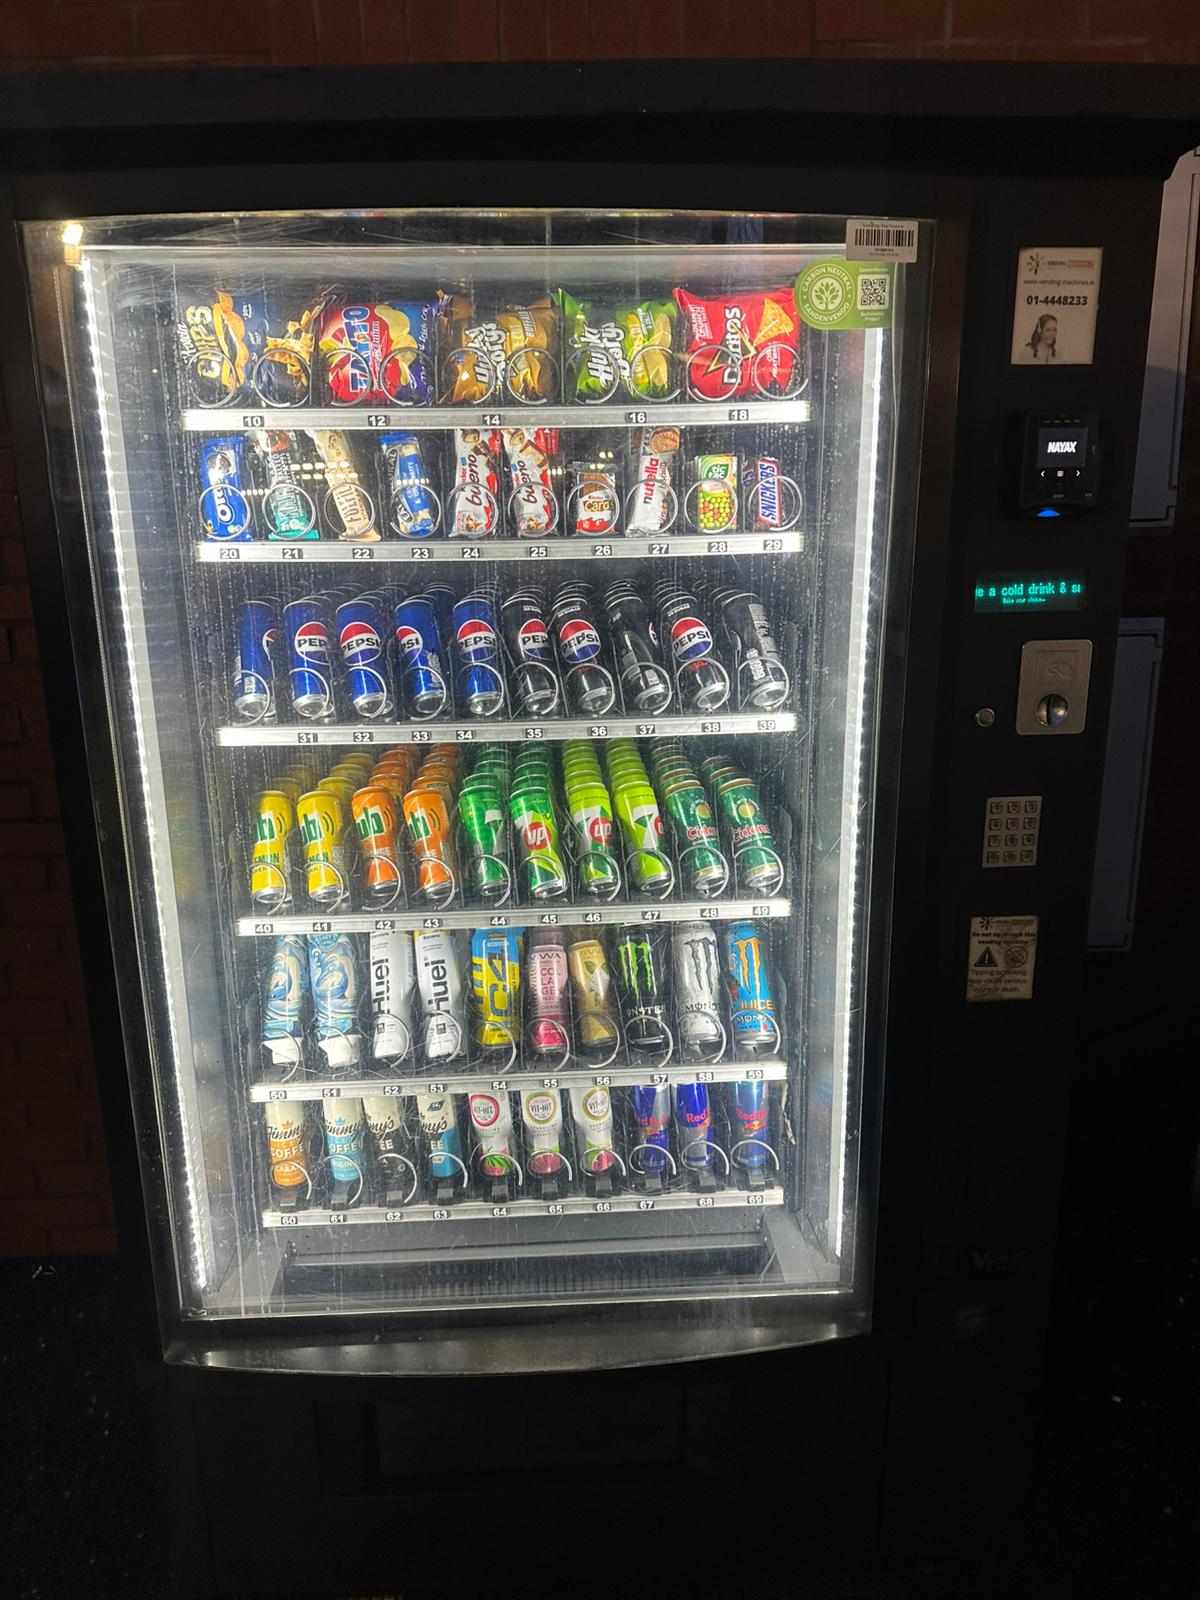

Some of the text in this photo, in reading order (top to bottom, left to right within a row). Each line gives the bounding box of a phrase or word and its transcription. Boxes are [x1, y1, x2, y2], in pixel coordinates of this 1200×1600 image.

[802, 266, 852, 292] CARBON NEUTRAL
[1026, 295, 1088, 306] 01-4448233
[804, 302, 850, 322] SANDENVENDO
[630, 413, 646, 423] 16
[731, 410, 748, 420] 18
[245, 417, 261, 427] 10
[369, 415, 386, 426] 12
[484, 415, 500, 425] 14
[1047, 441, 1077, 453] NAYAX
[711, 464, 726, 473] tic
[708, 471, 725, 479] tac
[465, 454, 483, 507] bueno
[517, 460, 538, 504] bueno
[643, 457, 660, 505] nutella
[759, 463, 777, 521] SNICKERS
[584, 499, 615, 512] Cards
[395, 503, 411, 521] EAT
[652, 544, 668, 554] 27
[711, 542, 726, 552] 28
[766, 540, 782, 550] 29
[221, 549, 237, 559] 20
[284, 549, 300, 558] 21
[354, 549, 370, 558] 22
[413, 549, 429, 558] 23
[463, 548, 479, 558] 24
[531, 547, 546, 557] 25
[595, 546, 611, 555] 26
[989, 587, 996, 596] a
[1001, 583, 1024, 596] cold
[1028, 582, 1055, 595] drink
[1060, 581, 1067, 594] &
[673, 632, 710, 649] PEPSI
[639, 726, 654, 734] 37
[704, 723, 719, 732] 38
[760, 721, 775, 730] 39
[457, 730, 472, 740] 34
[527, 729, 542, 738] 35
[592, 727, 607, 736] 36
[299, 733, 314, 742] 31
[354, 733, 370, 742] 32
[413, 732, 428, 741] 33
[644, 911, 659, 920] 47
[702, 909, 717, 917] 48
[754, 907, 769, 915] 49
[491, 917, 506, 926] 44
[542, 915, 557, 923] 45
[586, 913, 601, 922] 46
[314, 923, 329, 931] 41
[376, 921, 392, 929] 42
[424, 919, 439, 928] 43
[255, 925, 272, 933] 40
[372, 958, 390, 1017] Huel
[424, 958, 451, 1018] Huel
[541, 986, 556, 995] GE
[653, 1074, 667, 1082] 57
[699, 1072, 713, 1080] 58
[748, 1070, 762, 1078] 59
[544, 1080, 557, 1088] 55
[597, 1077, 610, 1085] 56
[430, 1084, 444, 1092] 53
[493, 1082, 507, 1090] 54
[271, 1091, 285, 1099] 50
[323, 1088, 337, 1097] 51
[385, 1087, 399, 1095] 52
[687, 1109, 707, 1123] Red
[750, 1196, 763, 1204] 69
[597, 1203, 610, 1211] 66
[640, 1201, 653, 1209] 67
[434, 1211, 447, 1219] 63
[493, 1208, 507, 1216] 64
[282, 1217, 297, 1225] 60
[331, 1215, 344, 1223] 61
[387, 1213, 400, 1221] 62
